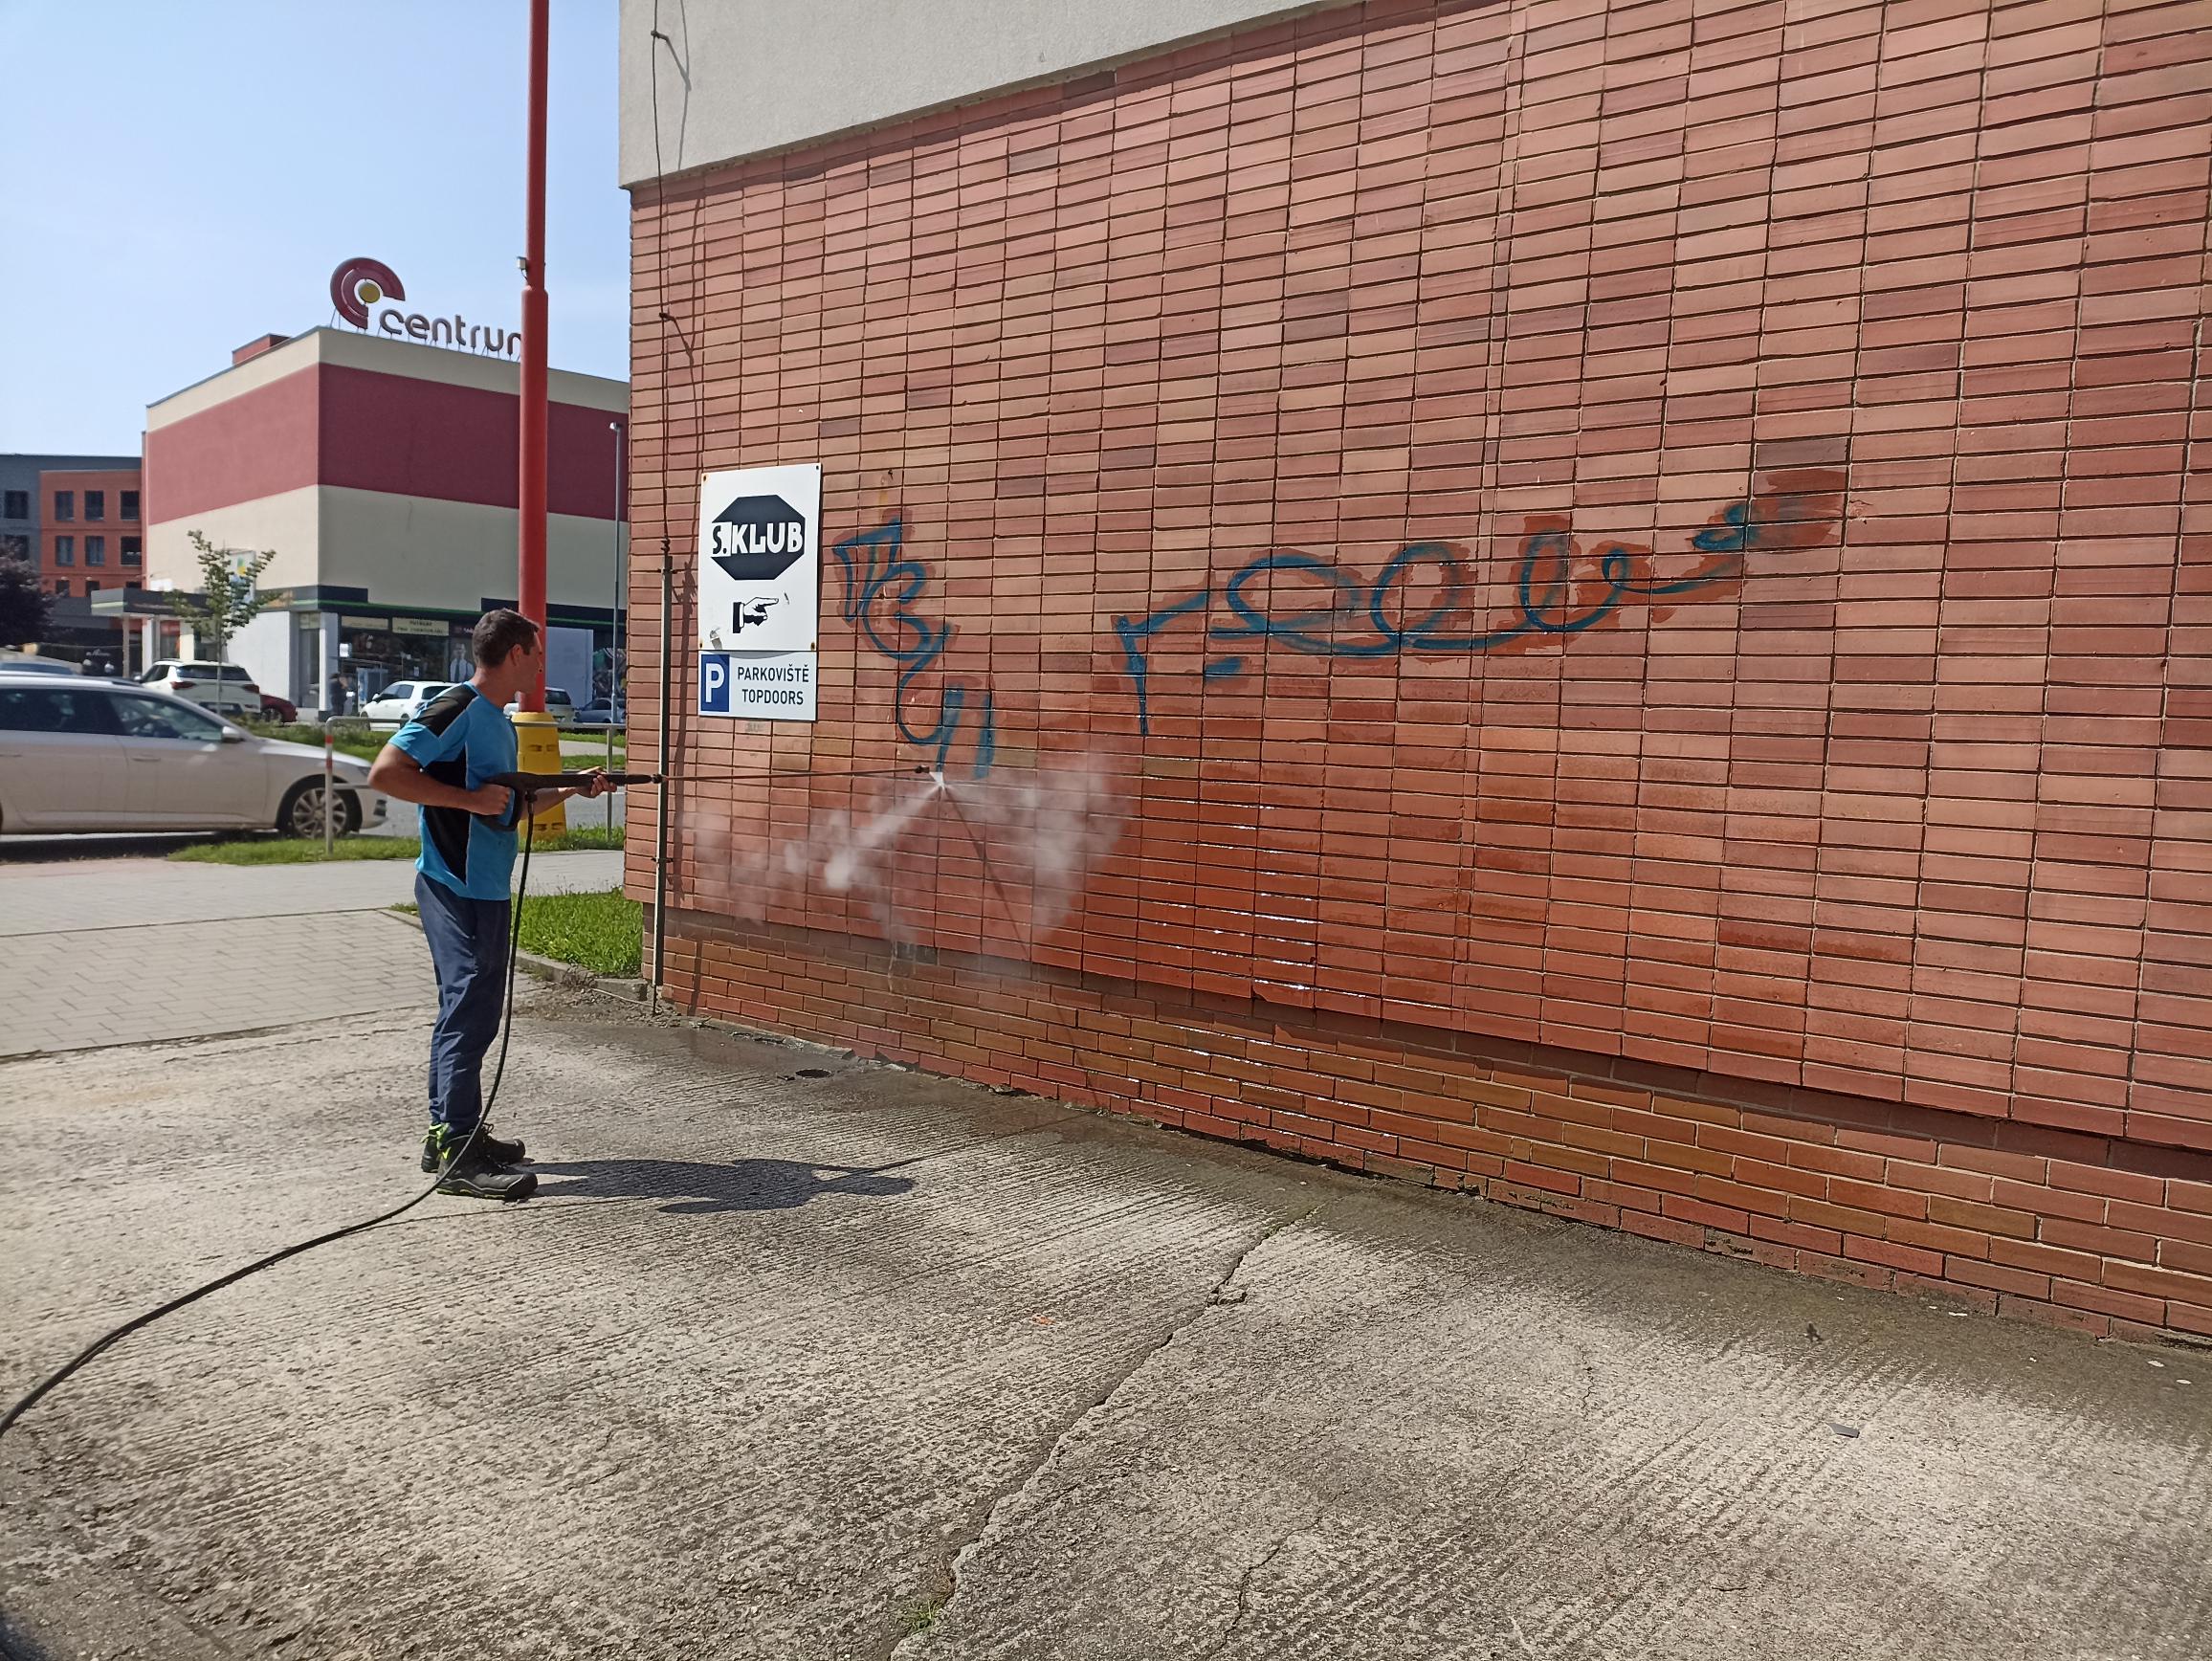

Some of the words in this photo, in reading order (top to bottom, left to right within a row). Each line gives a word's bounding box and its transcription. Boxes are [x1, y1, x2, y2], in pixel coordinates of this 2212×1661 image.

[712, 521, 804, 555] S.KLUB
[705, 663, 725, 703] P
[738, 663, 809, 683] PARKOVIŠTĚ
[741, 689, 804, 705] TOPDOORS
